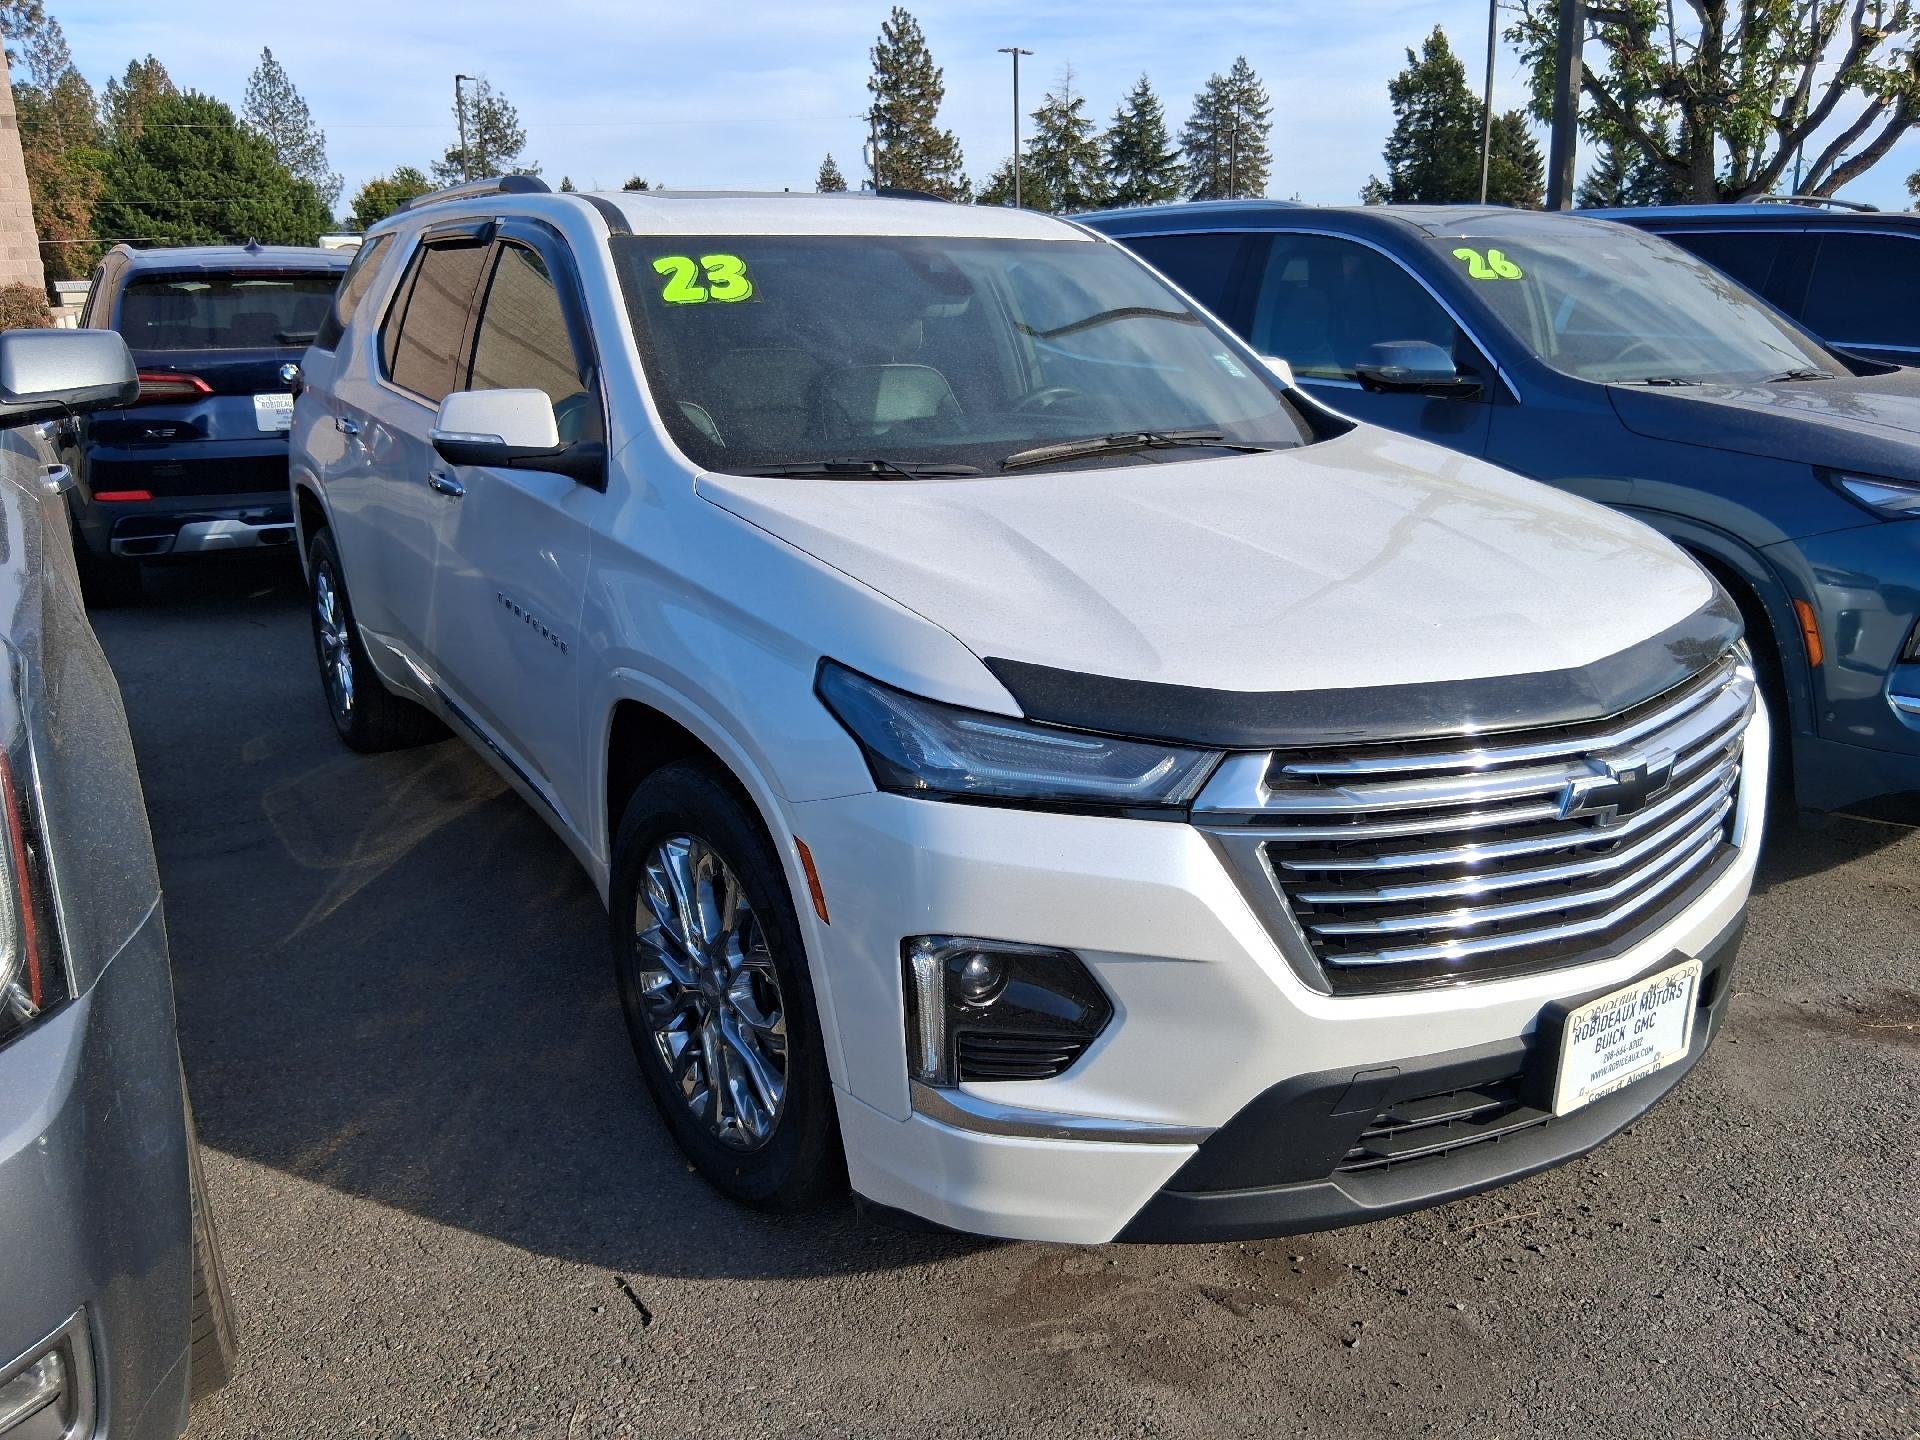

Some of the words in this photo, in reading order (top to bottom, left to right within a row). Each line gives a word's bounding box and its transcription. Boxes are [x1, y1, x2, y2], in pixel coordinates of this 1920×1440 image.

[652, 254, 753, 305] 23
[1452, 248, 1523, 281] 26
[497, 591, 569, 657] TRAVERSE
[1573, 1001, 1638, 1045] ROBIDEAUX
[1638, 981, 1684, 1016] MOTORS
[1595, 1024, 1627, 1053] BUICK
[1633, 1012, 1657, 1035] GMC
